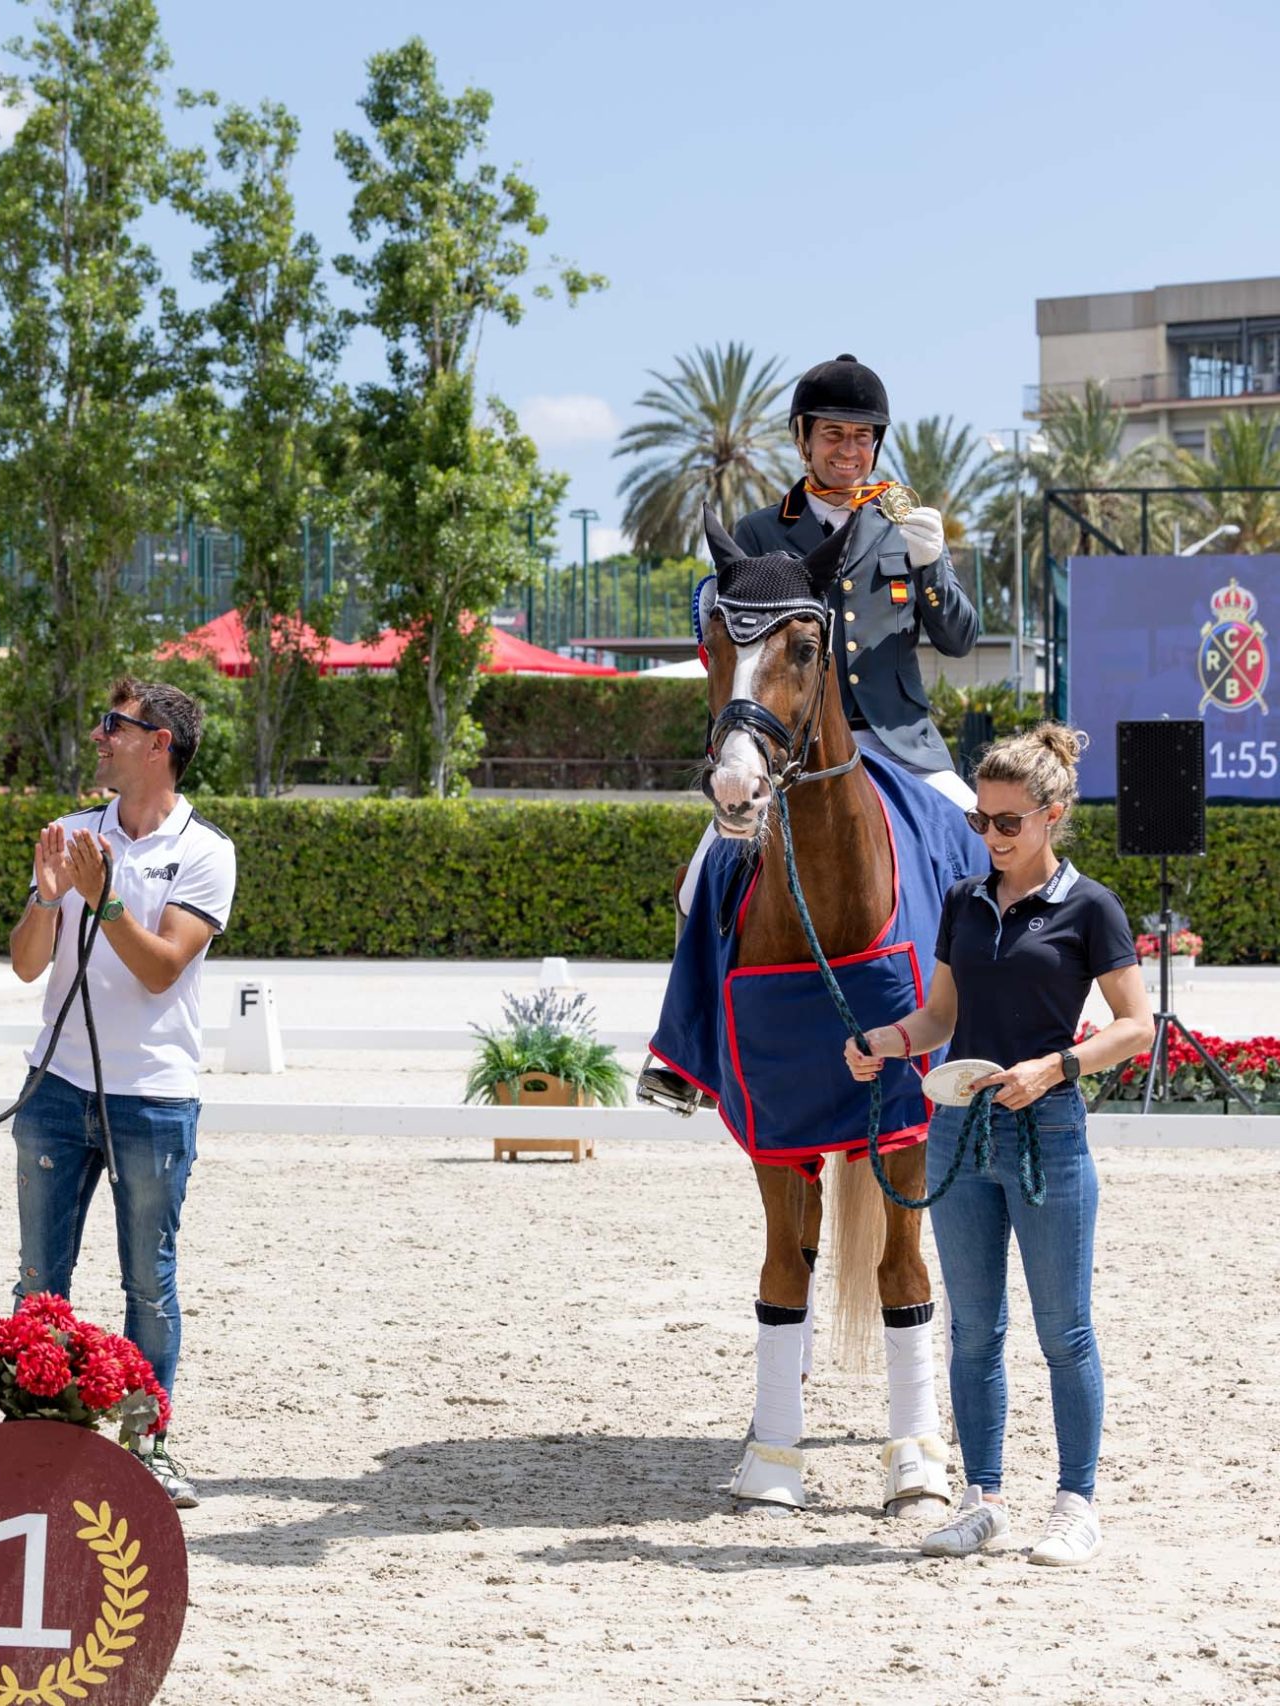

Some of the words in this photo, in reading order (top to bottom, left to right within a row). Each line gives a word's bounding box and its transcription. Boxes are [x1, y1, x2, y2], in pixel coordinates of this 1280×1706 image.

[1224, 628, 1239, 649] C
[1206, 650, 1221, 671] R
[1246, 650, 1261, 670] P
[1225, 679, 1240, 699] B
[1209, 740, 1278, 779] 1:55
[240, 989, 259, 1017] F
